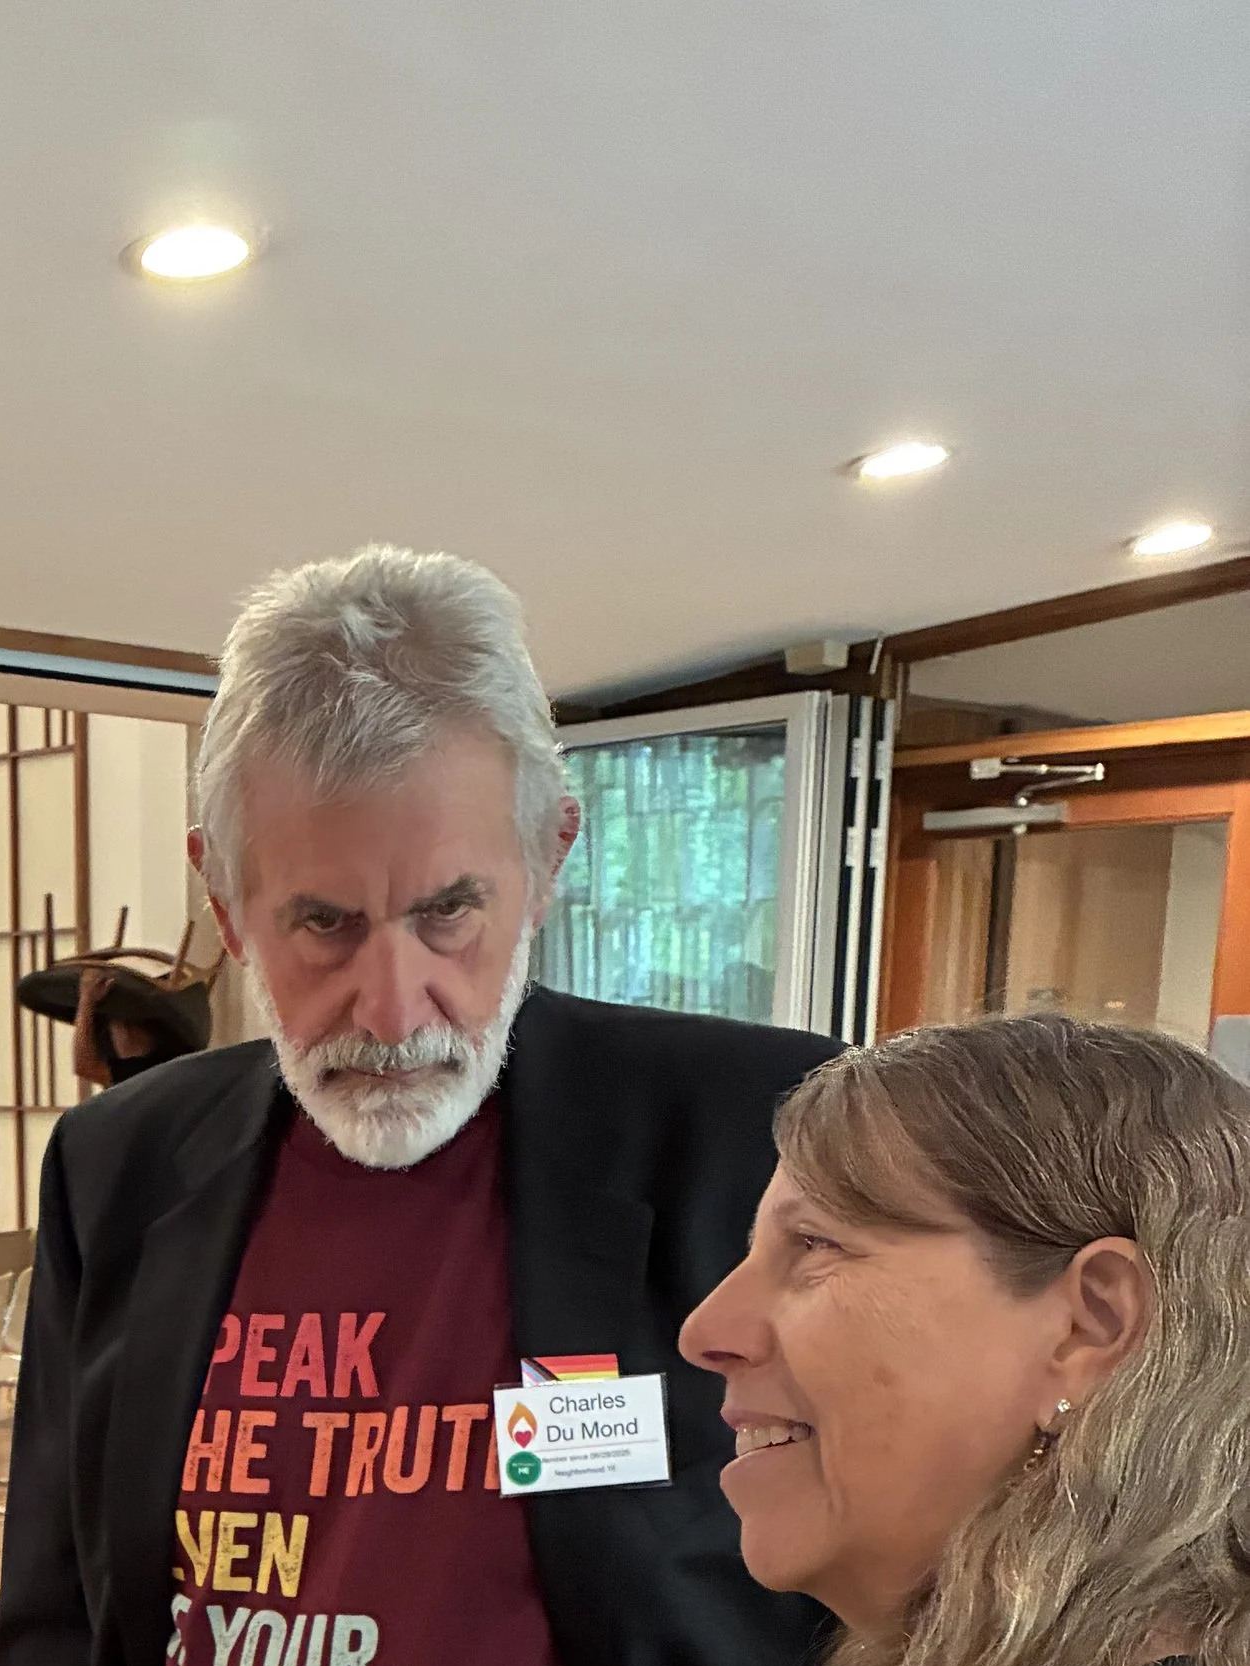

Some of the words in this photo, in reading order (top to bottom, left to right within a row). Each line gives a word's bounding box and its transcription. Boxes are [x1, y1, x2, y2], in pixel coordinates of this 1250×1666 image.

[202, 1312, 386, 1397] PEAK
[547, 1425, 574, 1443] Du
[581, 1418, 638, 1440] Mond
[550, 1393, 626, 1414] Charles
[181, 1409, 277, 1494] HE
[302, 1403, 500, 1497] TRUT
[172, 1509, 309, 1598] VEN
